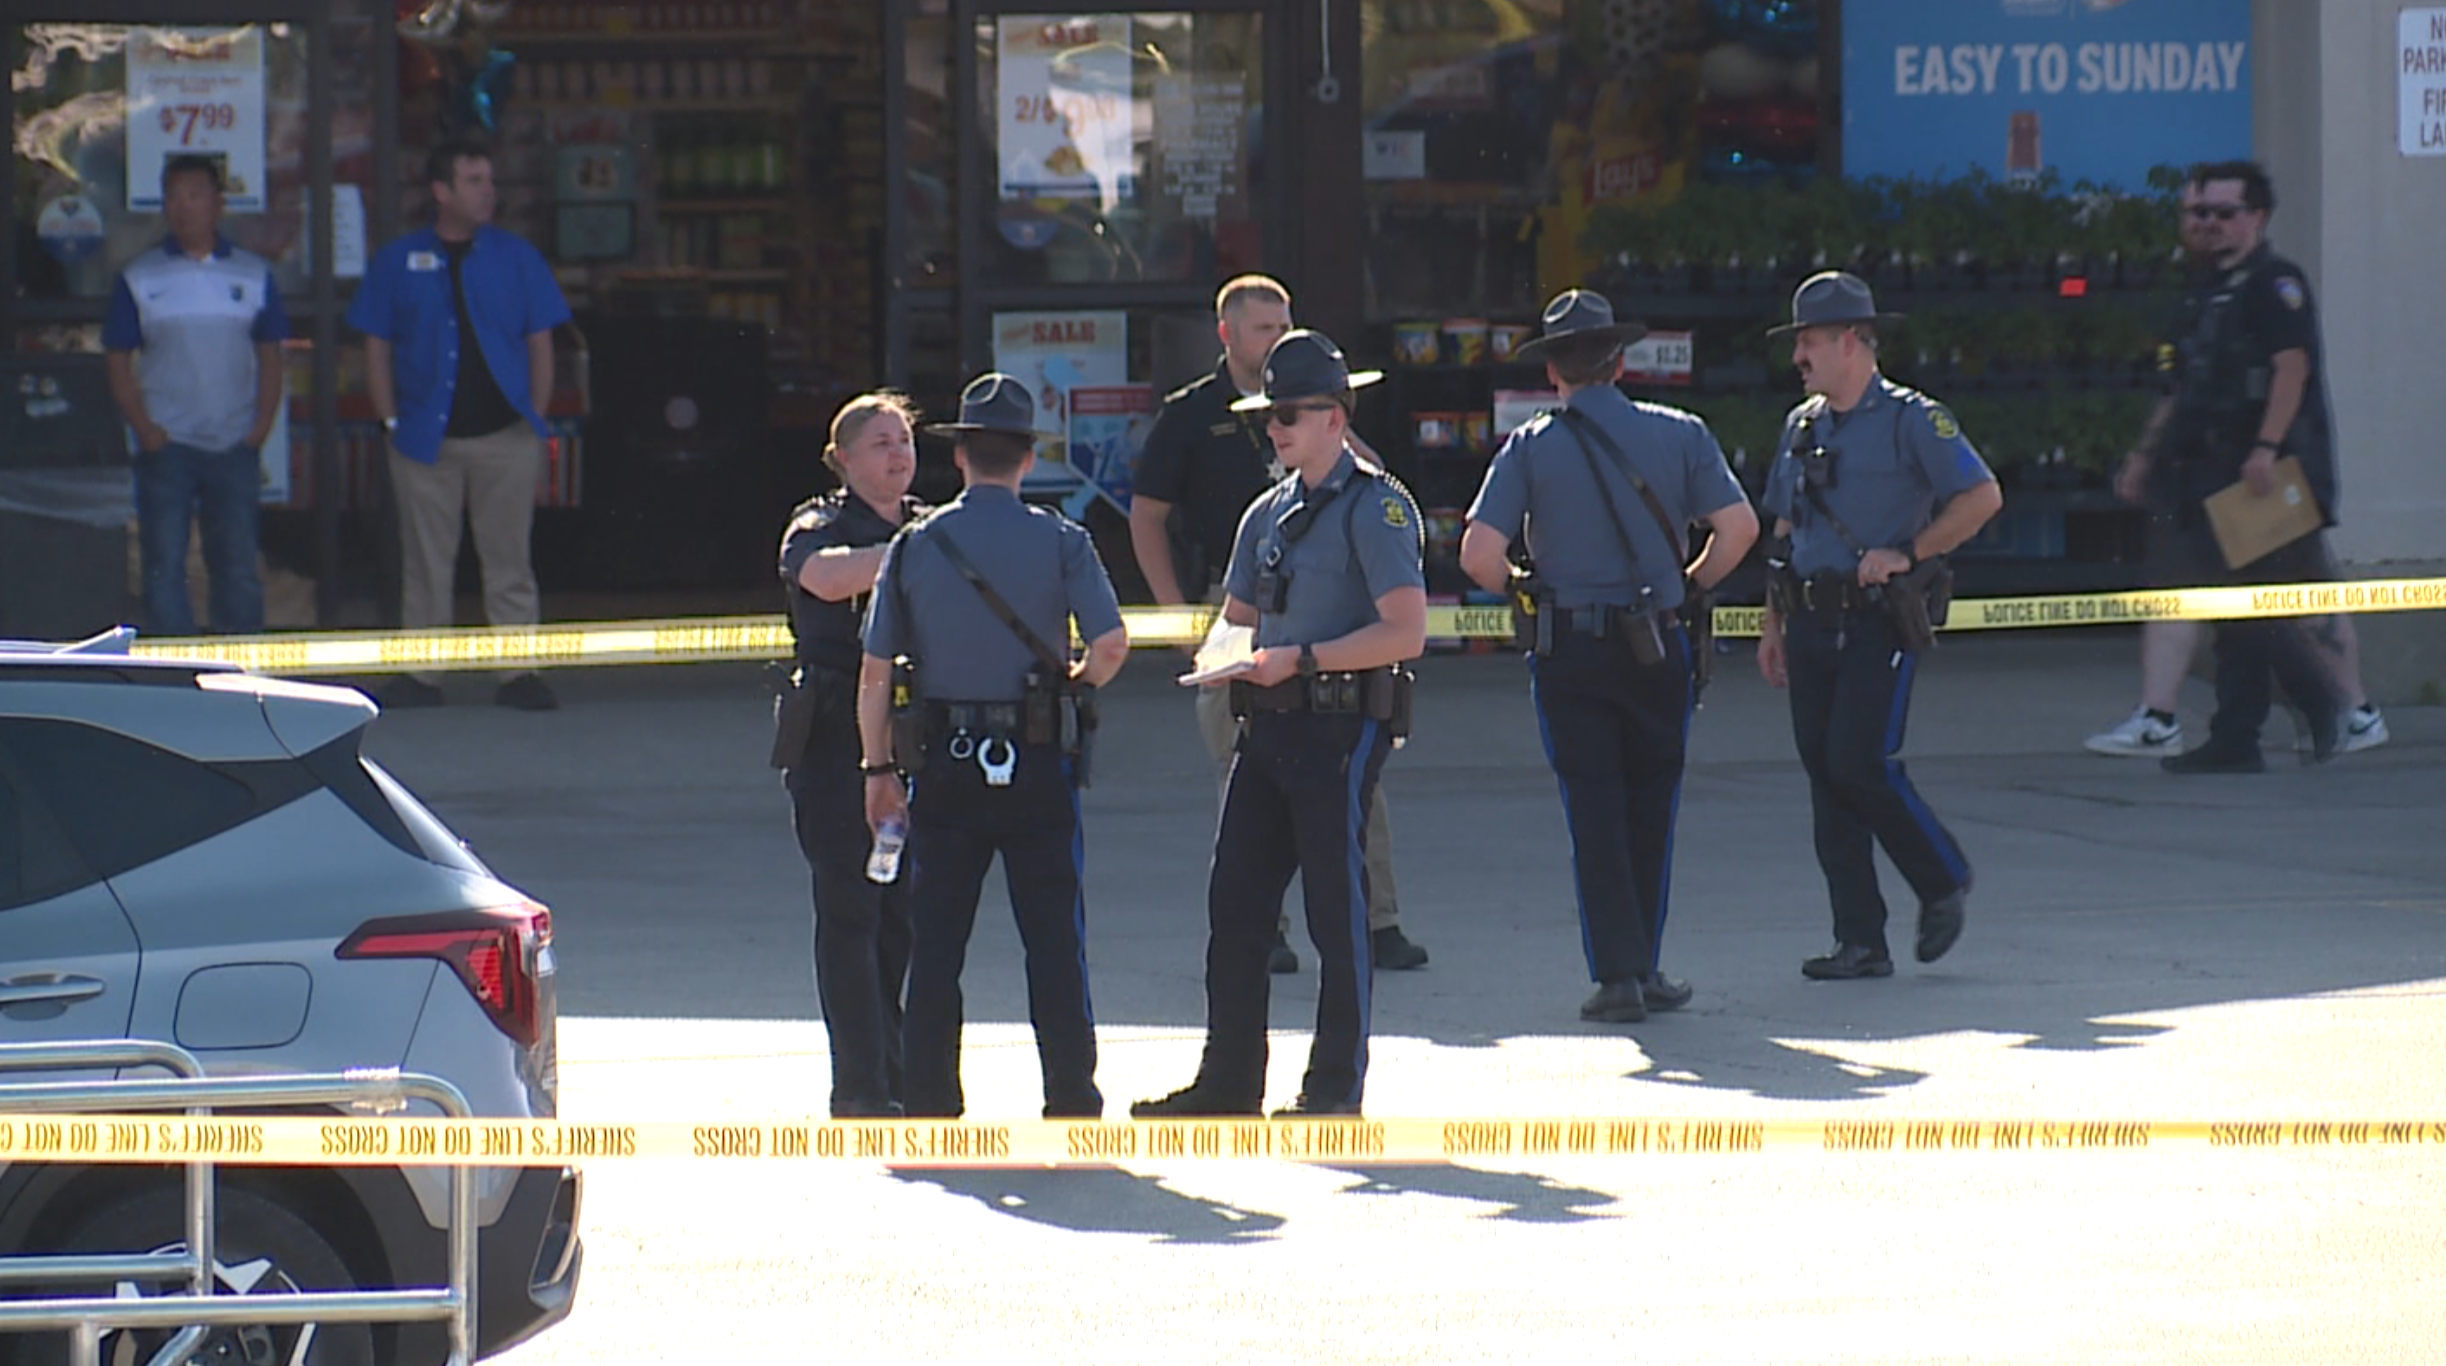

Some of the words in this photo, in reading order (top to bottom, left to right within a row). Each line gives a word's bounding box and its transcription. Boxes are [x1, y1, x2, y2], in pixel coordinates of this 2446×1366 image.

[2431, 14, 2446, 41] N
[1894, 44, 2003, 97] EASY
[2012, 43, 2069, 95] TO
[2077, 41, 2245, 94] SUNDAY
[2421, 121, 2446, 147] LA
[1032, 320, 1094, 344] SALE
[25, 1123, 61, 1152] NOT
[71, 1124, 96, 1152] DO
[106, 1124, 150, 1152] LINE
[159, 1124, 263, 1153] SHERIFF'S
[321, 1126, 388, 1155] CROSS
[397, 1126, 435, 1156] NOT
[445, 1127, 470, 1155] DO
[480, 1126, 523, 1155] LINE
[532, 1126, 636, 1156] SHERIFF'S
[694, 1126, 760, 1157] CROSS
[770, 1126, 807, 1156] NOT
[818, 1127, 843, 1156] DO
[853, 1127, 895, 1156] LINE
[904, 1126, 1009, 1157] SHERIFF'S
[1068, 1126, 1135, 1157] CROSS
[1146, 1126, 1183, 1156] NOT
[1193, 1126, 1219, 1156] DO
[1227, 1125, 1270, 1156] LINE
[1281, 1122, 1385, 1156] SHERIFF'S
[1443, 1122, 1511, 1155] CROSS
[1521, 1122, 1560, 1154] NOT
[1569, 1122, 1595, 1153] DO
[1605, 1122, 1648, 1152] LINE
[1823, 1121, 1894, 1150] CROSS
[1951, 1122, 1980, 1149] DO
[2209, 1122, 2282, 1146] CROSS
